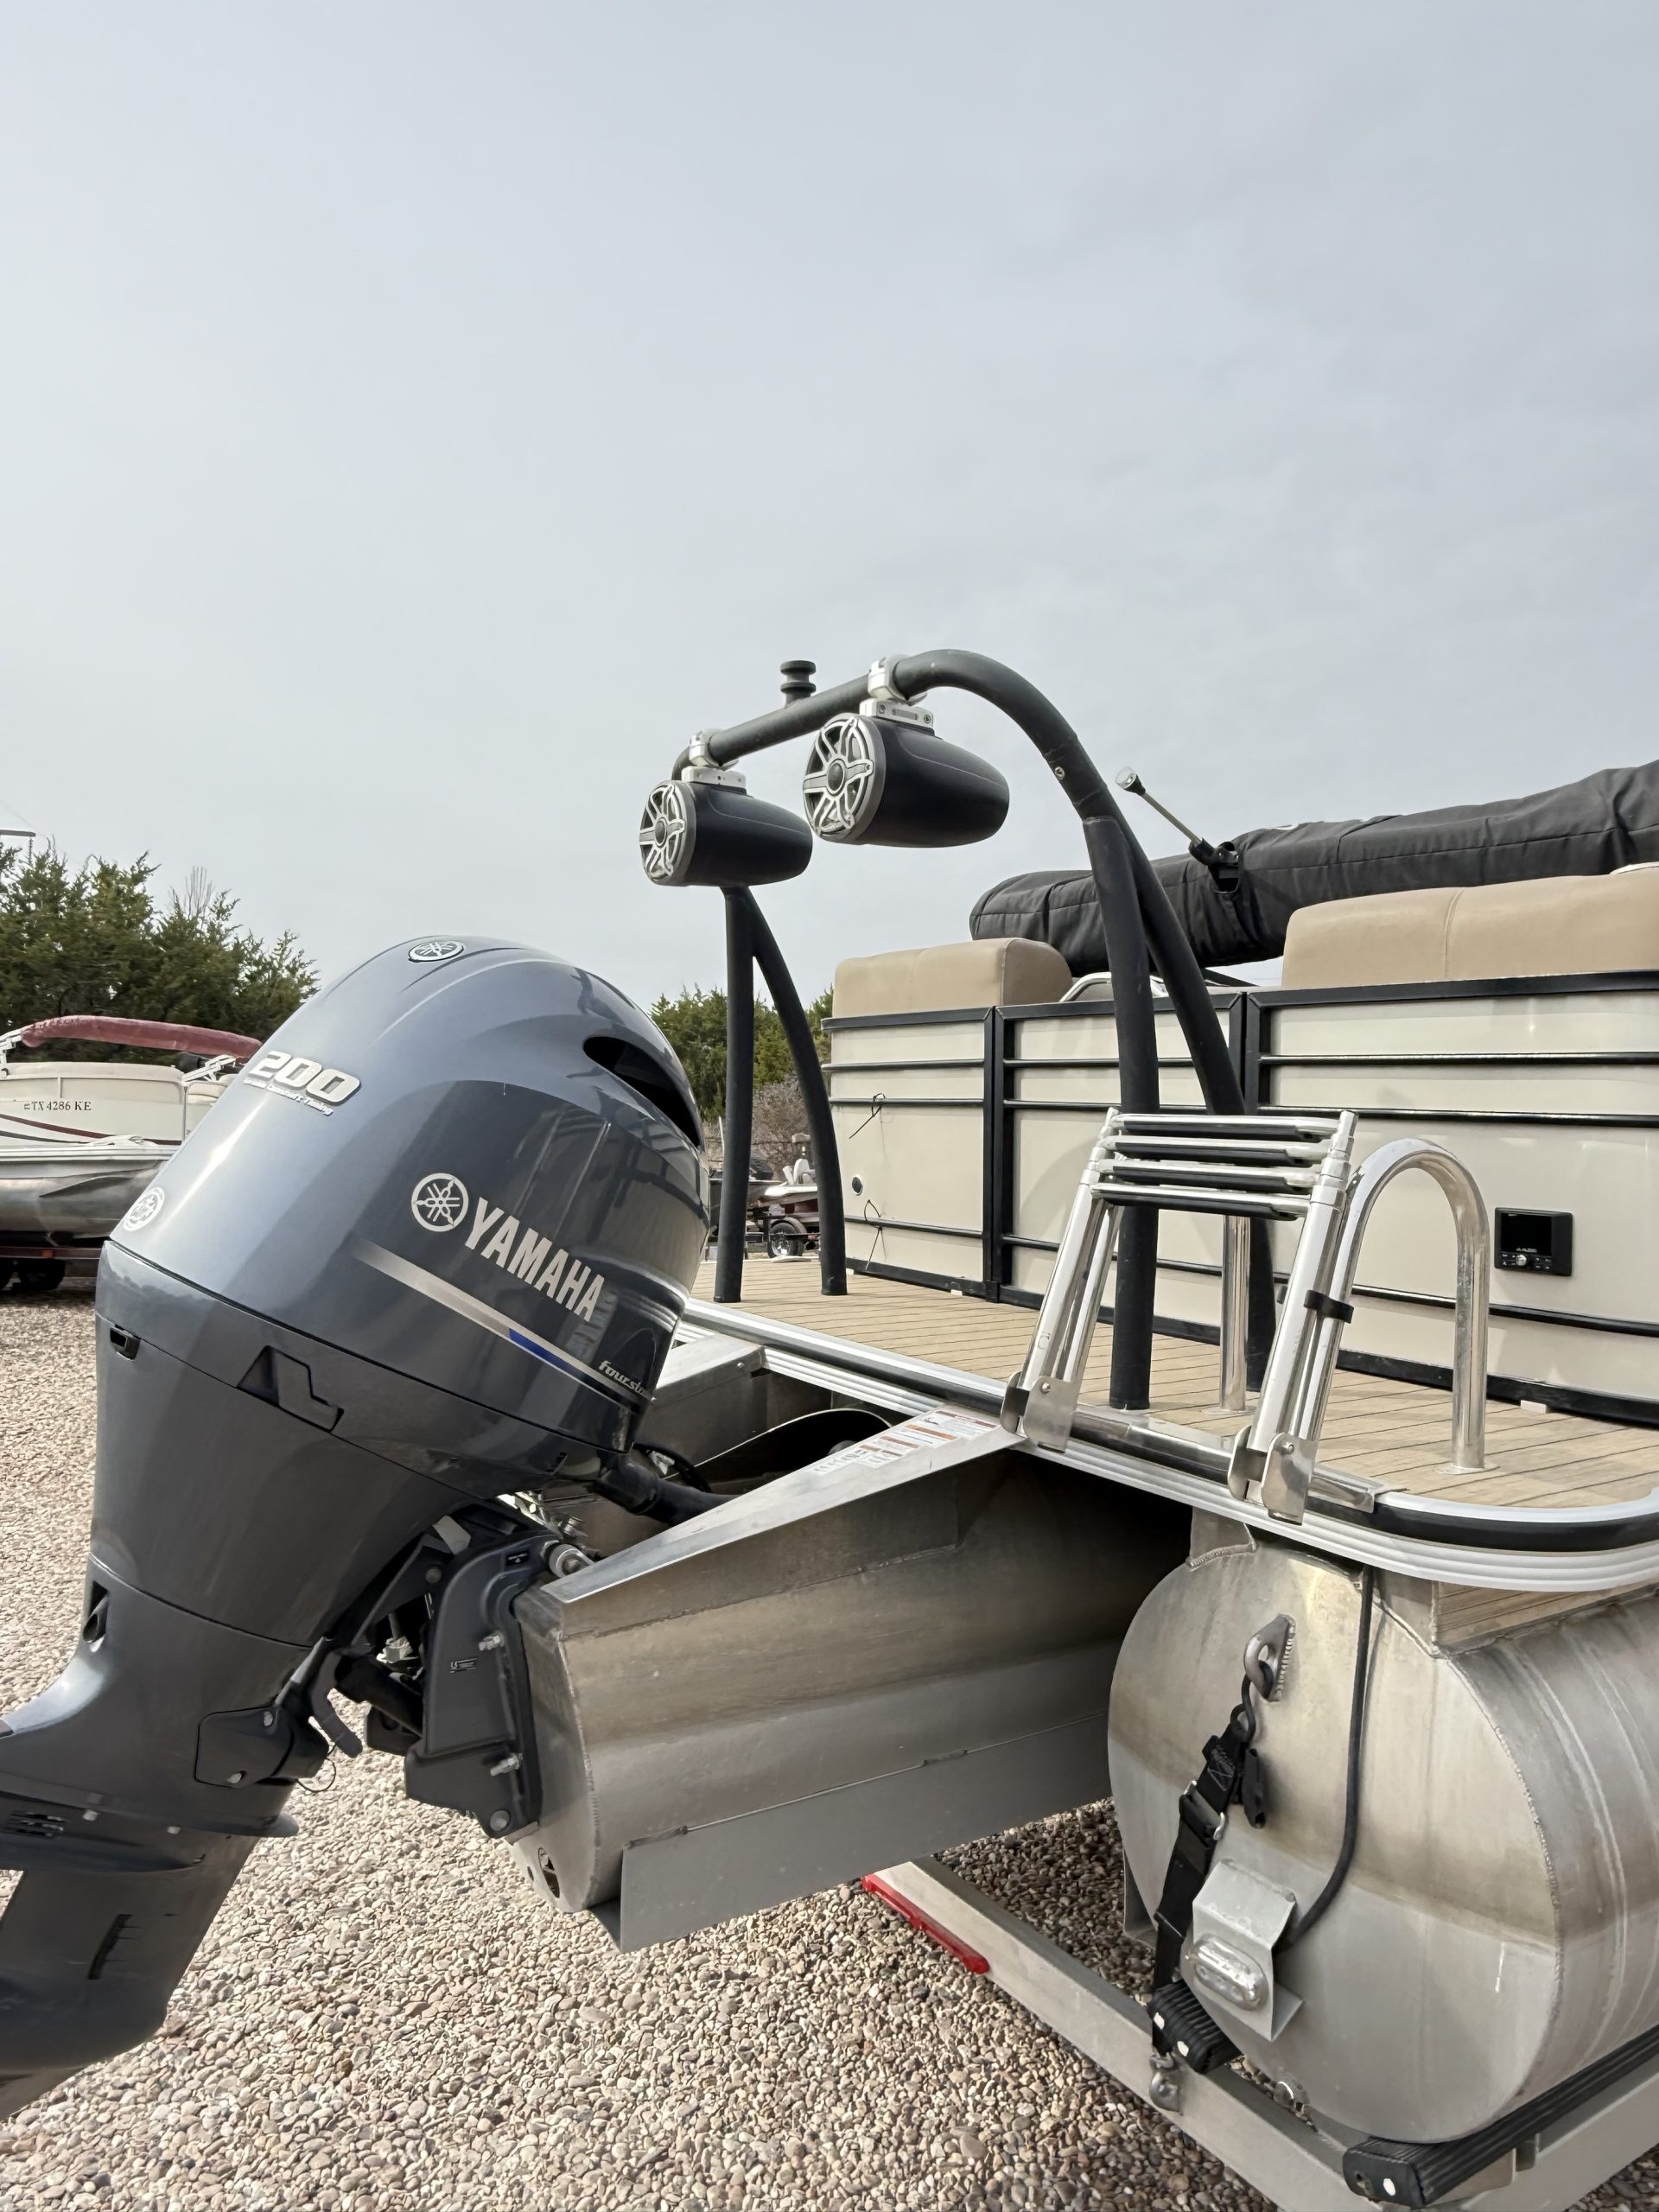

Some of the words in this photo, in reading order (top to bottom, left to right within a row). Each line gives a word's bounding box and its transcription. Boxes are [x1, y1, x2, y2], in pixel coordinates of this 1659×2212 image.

[248, 1050, 361, 1104] 200
[31, 1101, 44, 1111] TX
[47, 1101, 71, 1111] 4286
[74, 1101, 92, 1111] KE
[465, 1197, 605, 1322] YAMAHA
